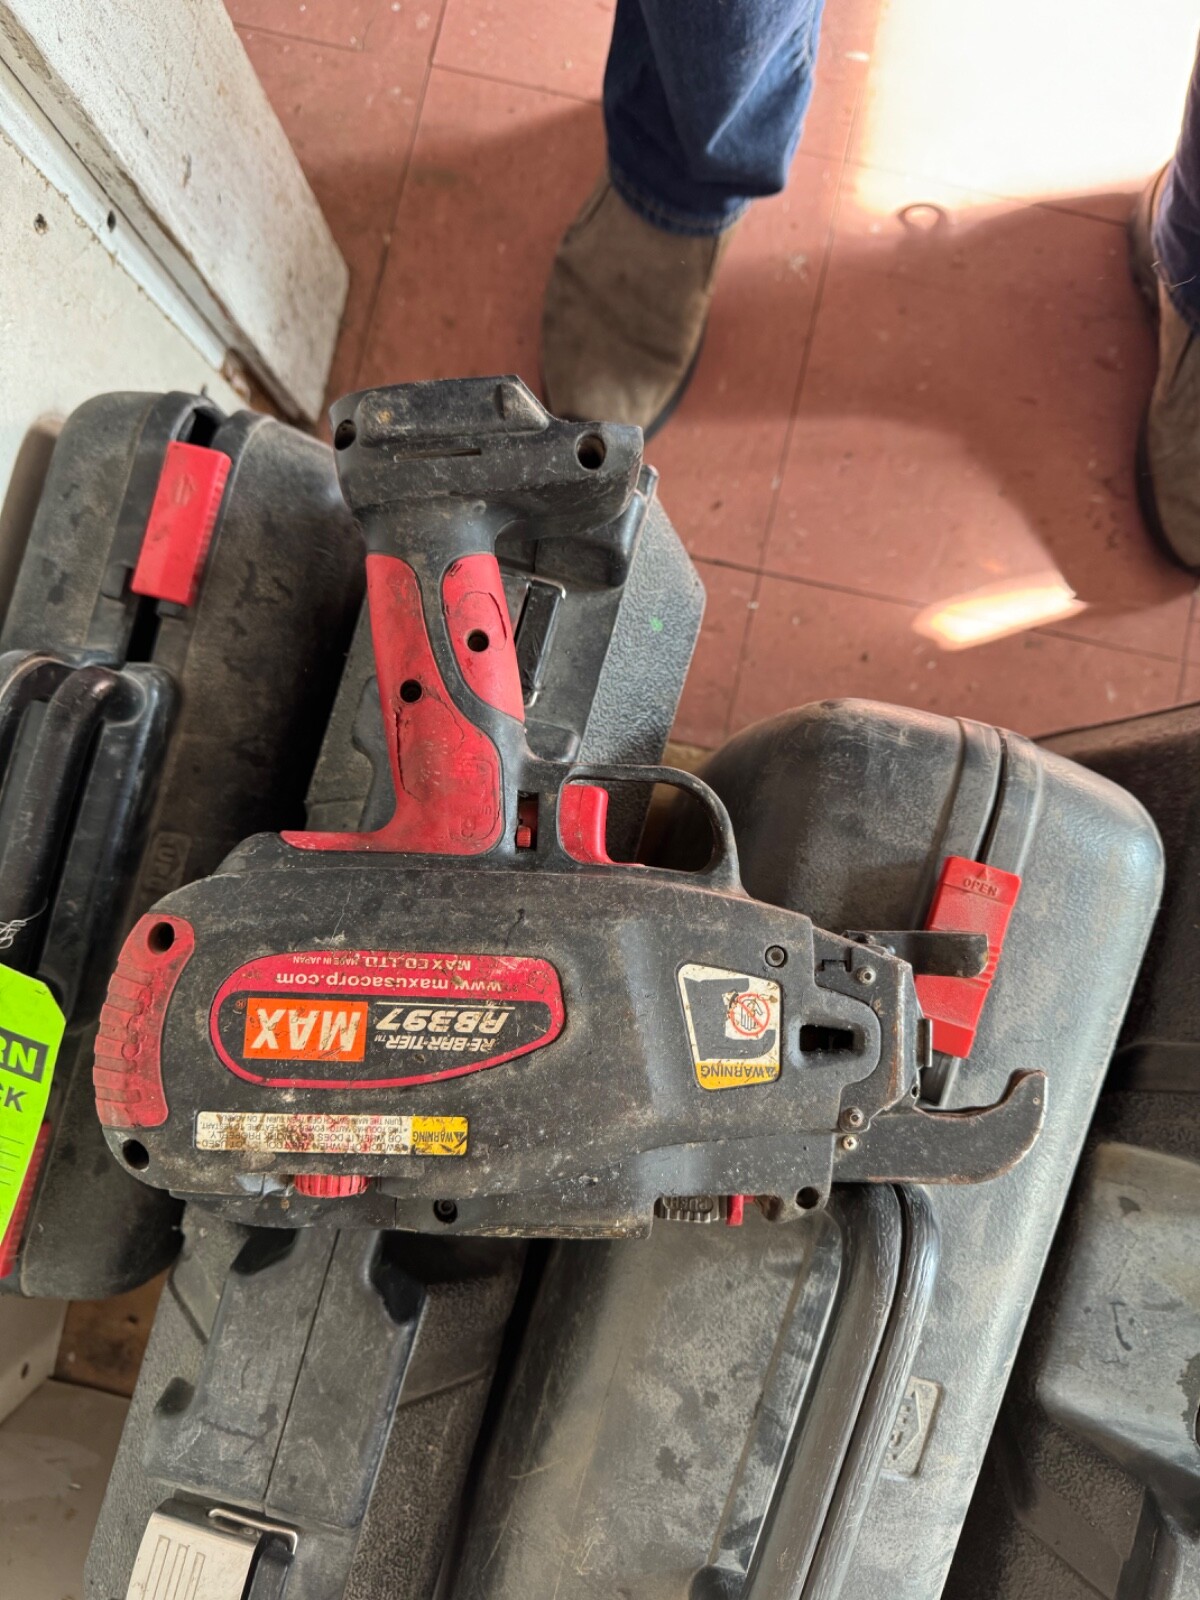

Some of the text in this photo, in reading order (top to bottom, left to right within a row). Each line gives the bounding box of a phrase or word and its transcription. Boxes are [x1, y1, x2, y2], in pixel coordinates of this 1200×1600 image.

[963, 878, 998, 896] OPEN
[293, 956, 321, 965] JAPAN
[322, 957, 332, 965] IN
[432, 959, 471, 971] MAX
[275, 972, 502, 992] wwwmaxusacorp.com
[375, 1008, 510, 1034] RB397
[251, 1008, 362, 1052] MAX
[700, 1064, 765, 1079] WARNING
[0, 1082, 27, 1113] K
[318, 1134, 344, 1142] DOES
[388, 1135, 401, 1143] OR
[412, 1131, 454, 1142] WARNING
